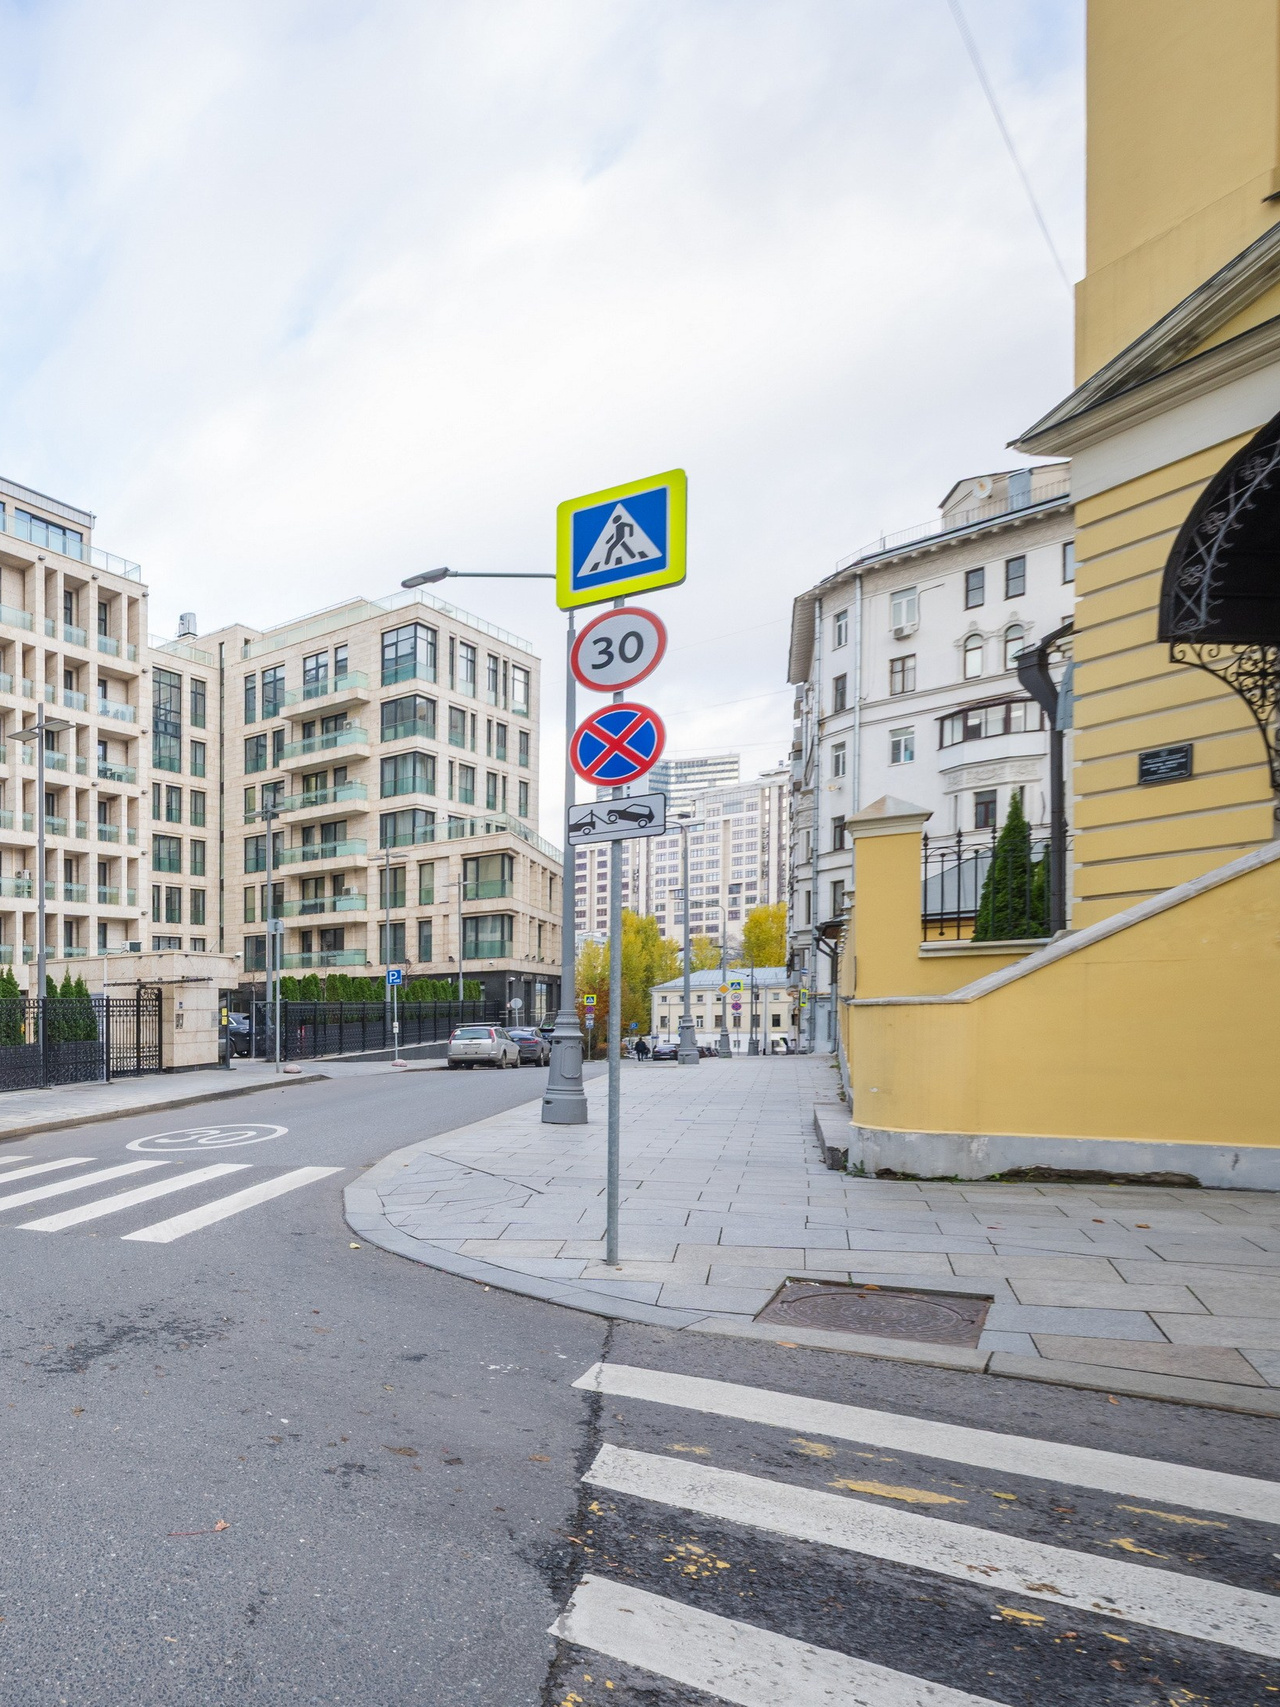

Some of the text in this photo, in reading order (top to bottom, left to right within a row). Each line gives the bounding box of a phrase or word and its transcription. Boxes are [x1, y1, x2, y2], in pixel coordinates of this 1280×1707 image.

[591, 631, 644, 670] 30
[389, 971, 398, 983] P
[154, 1129, 257, 1144] 30
